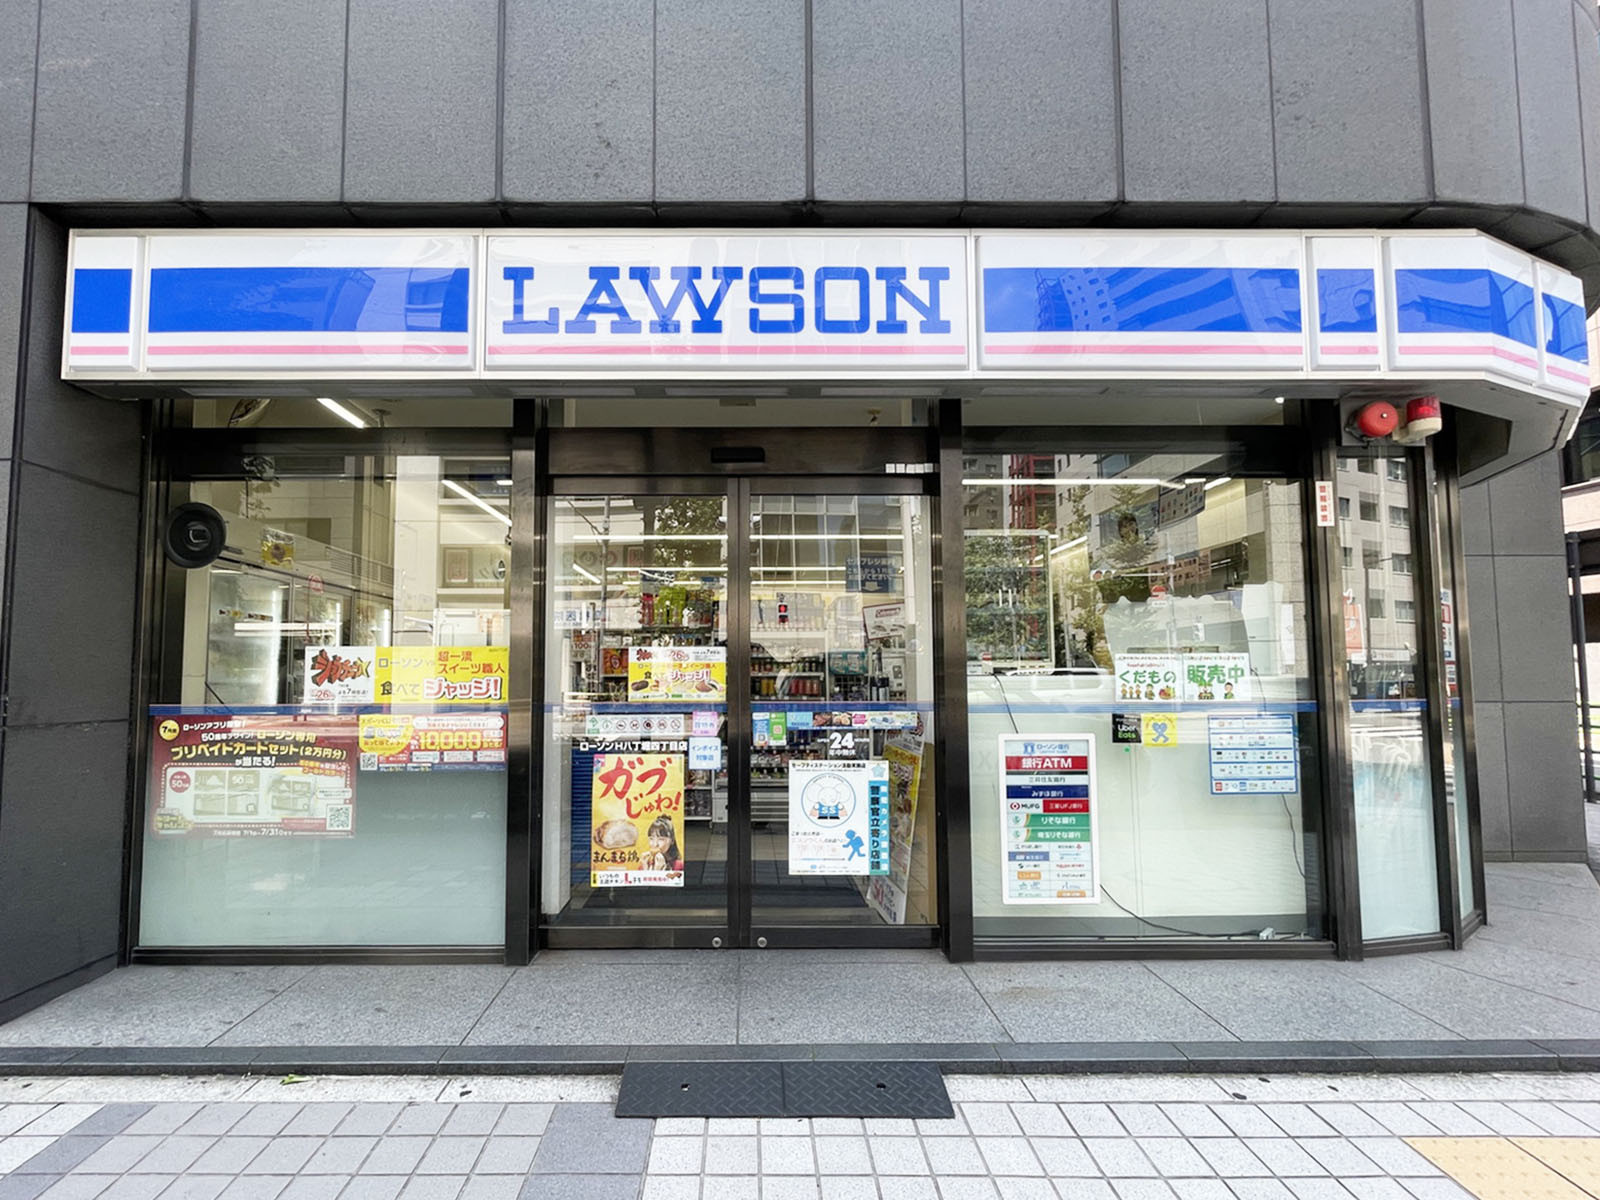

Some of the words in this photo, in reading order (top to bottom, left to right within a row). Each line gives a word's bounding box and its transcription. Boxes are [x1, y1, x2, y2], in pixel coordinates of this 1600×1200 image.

[503, 266, 950, 334] LAWSON
[438, 650, 473, 662] 超一流
[378, 657, 424, 668] ローソン
[439, 663, 505, 674] スイーツ職人
[1187, 664, 1245, 684] 販売中
[1119, 670, 1177, 684] くだもの
[380, 681, 420, 696] 食べて
[1117, 724, 1137, 732] Uber
[830, 732, 855, 749] 24
[691, 744, 719, 752] インボイス
[1021, 757, 1072, 768] 銀行ATM
[1041, 817, 1076, 825] りそな銀行
